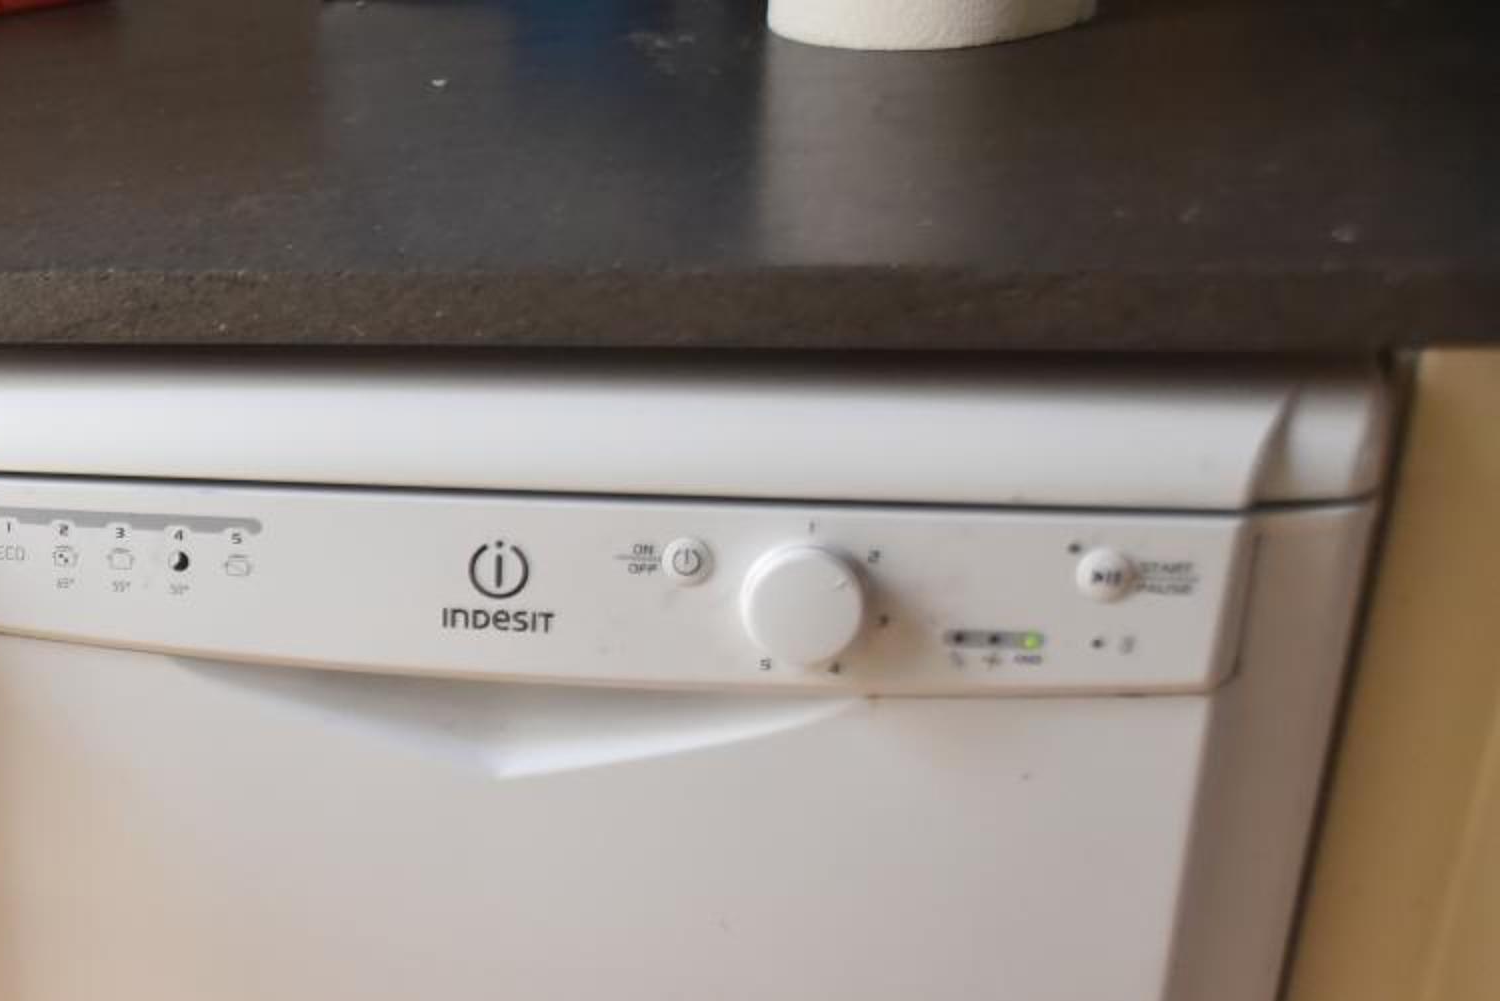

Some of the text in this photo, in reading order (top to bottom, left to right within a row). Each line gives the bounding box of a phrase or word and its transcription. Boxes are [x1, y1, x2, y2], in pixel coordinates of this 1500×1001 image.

[58, 524, 69, 536] 2
[115, 527, 125, 539] 3
[174, 529, 184, 541] 4
[231, 532, 243, 544] 5
[632, 543, 655, 555] ON
[627, 563, 659, 575] OFF
[441, 606, 555, 634] INDESIT
